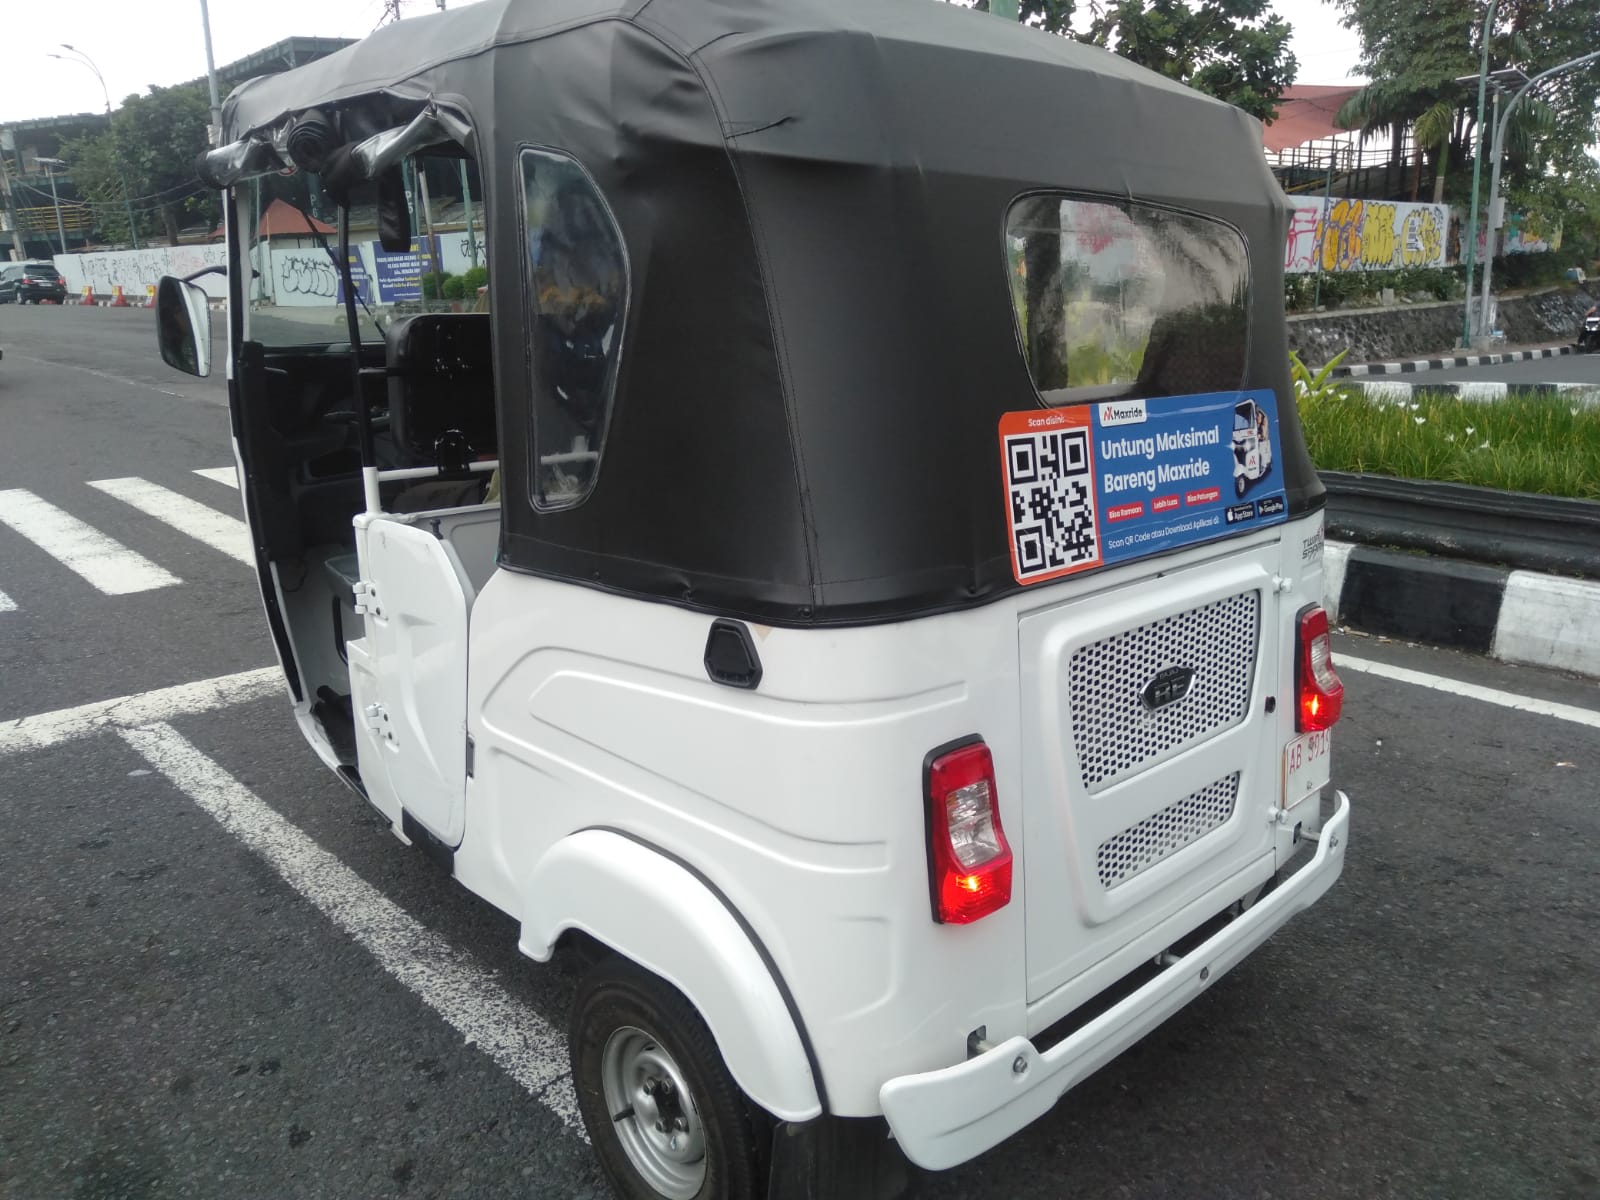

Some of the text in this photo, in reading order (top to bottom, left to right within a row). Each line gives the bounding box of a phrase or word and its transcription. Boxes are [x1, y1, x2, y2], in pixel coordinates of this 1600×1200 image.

[1027, 418, 1045, 427] Scan
[1113, 407, 1143, 420] Maxride
[1101, 425, 1219, 460] Untung Maksimal
[1104, 457, 1210, 493] Bareng Maxride
[1108, 540, 1125, 549] Scan
[1125, 535, 1134, 545] QR
[1134, 531, 1150, 542] Code
[1151, 528, 1165, 539] atau
[1165, 521, 1193, 536] Download
[1193, 517, 1213, 531] Aplikasi
[1289, 743, 1302, 774] AB
